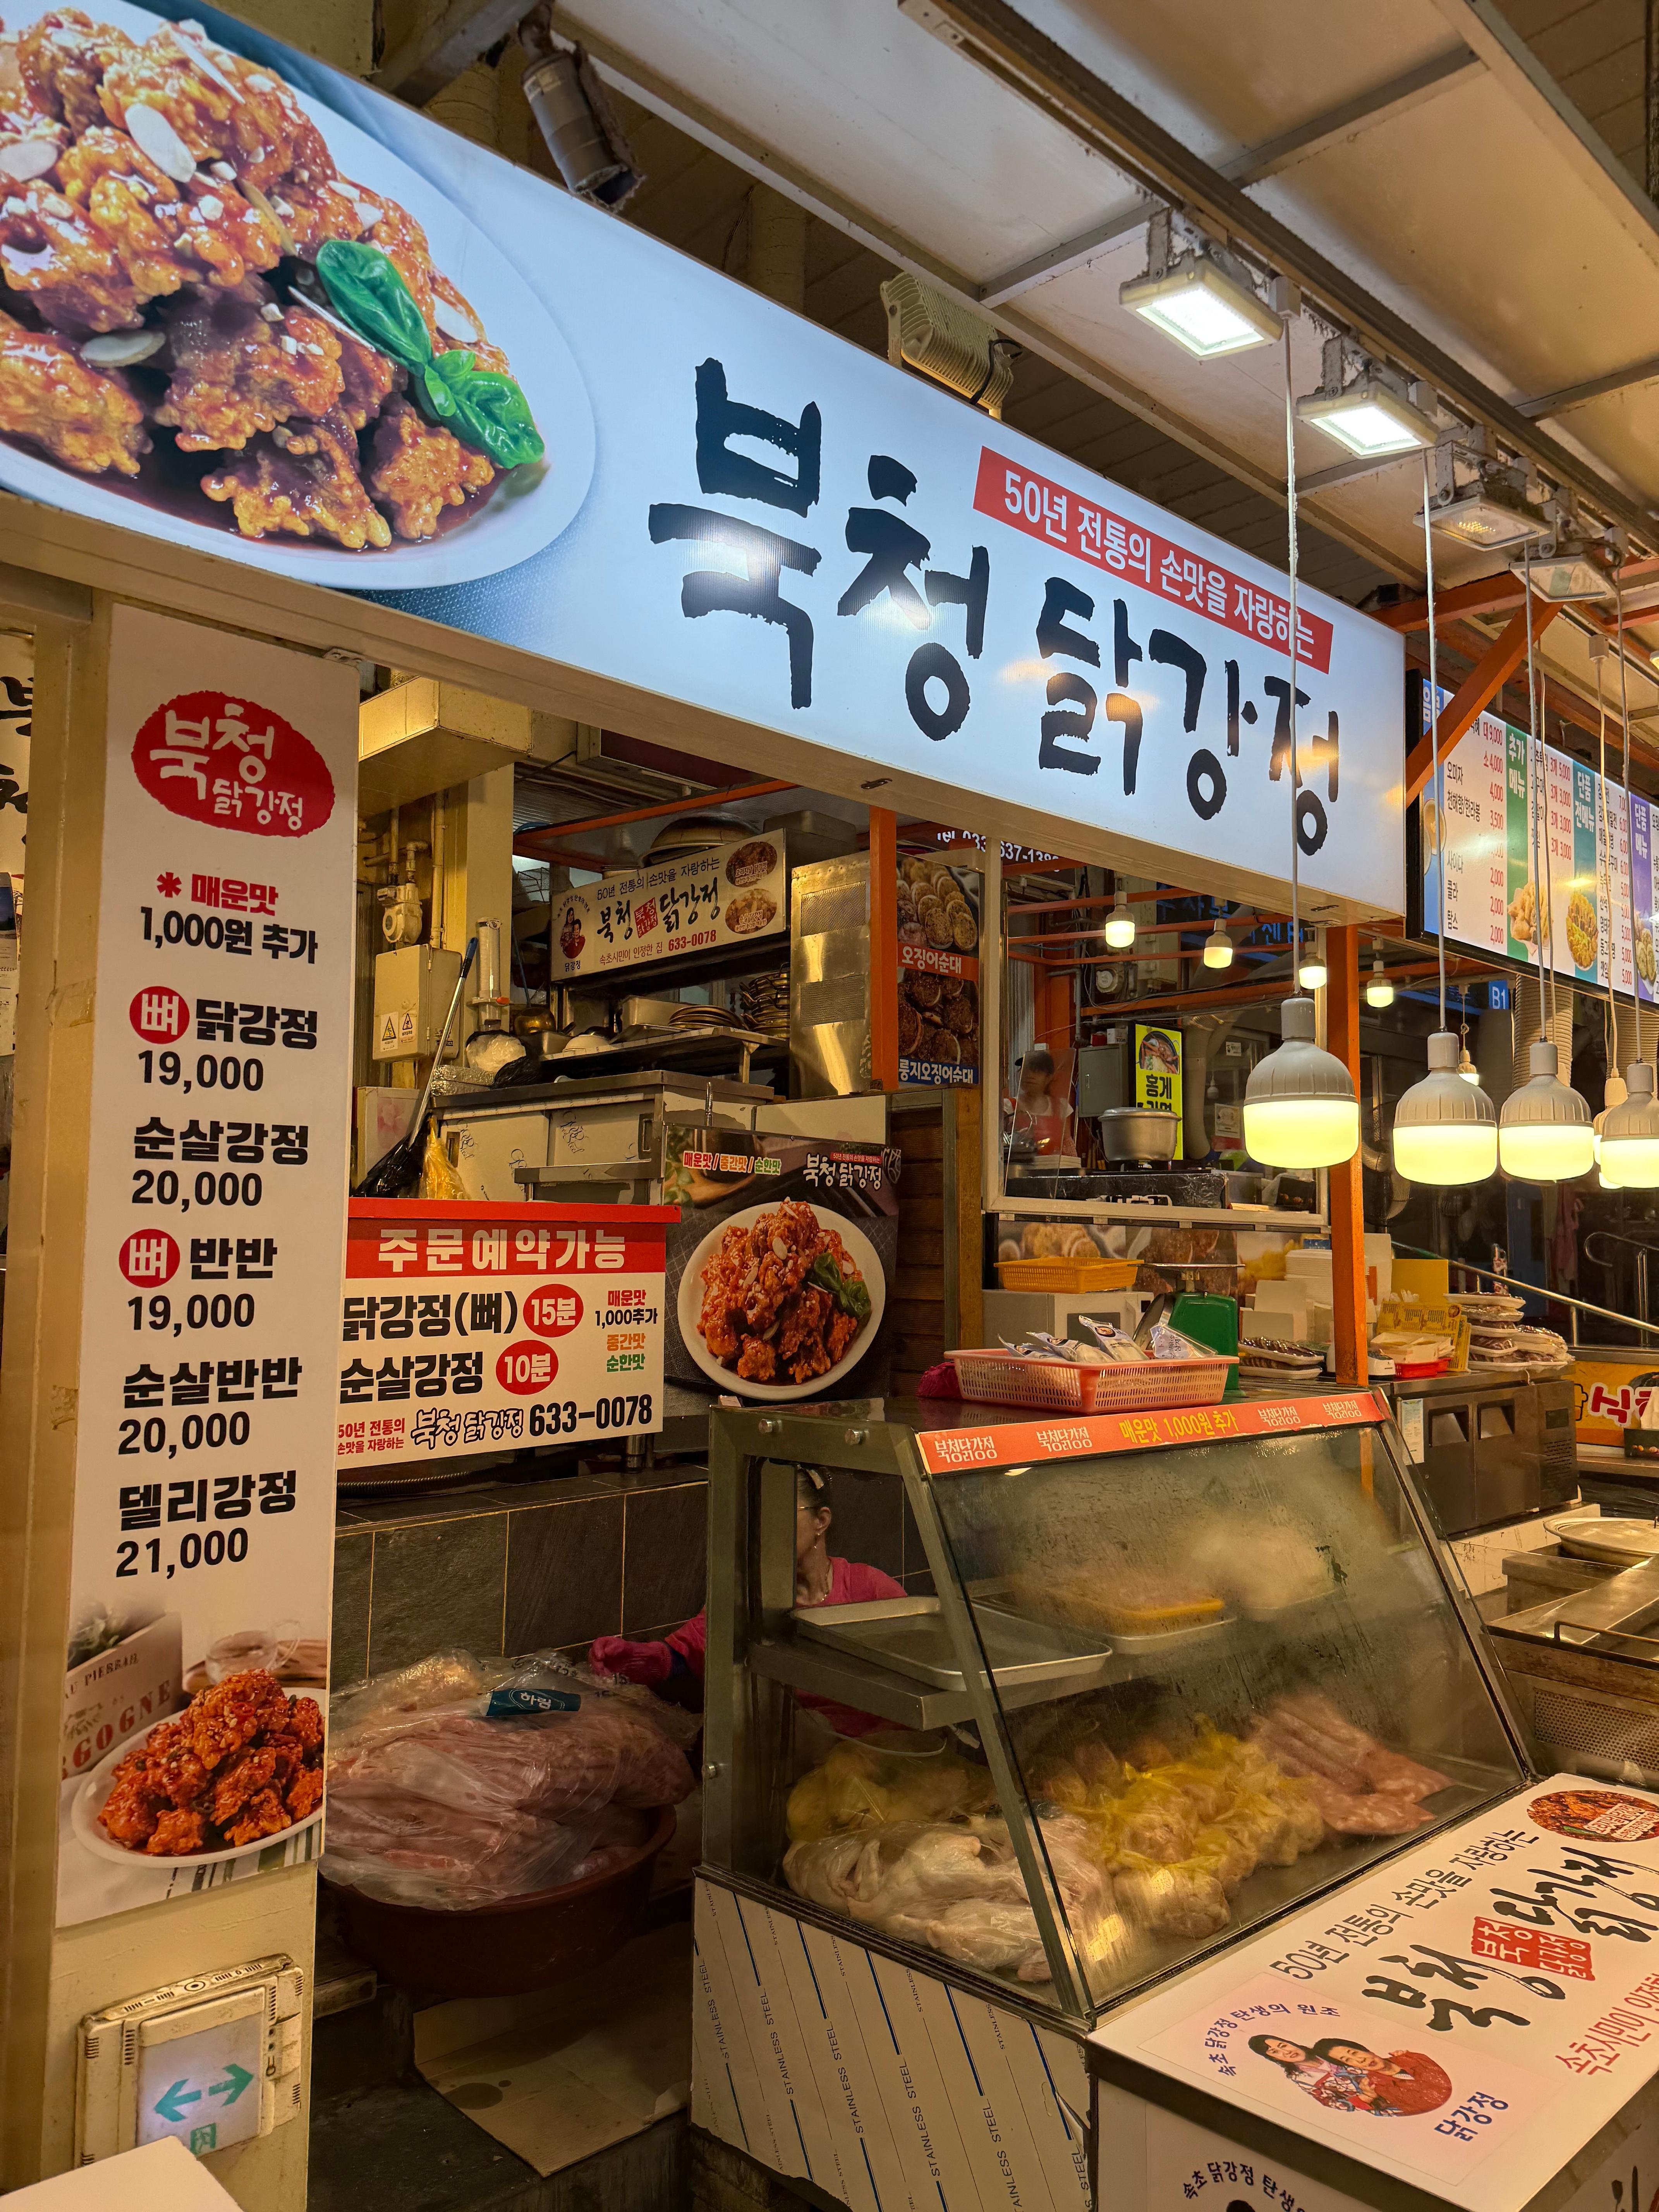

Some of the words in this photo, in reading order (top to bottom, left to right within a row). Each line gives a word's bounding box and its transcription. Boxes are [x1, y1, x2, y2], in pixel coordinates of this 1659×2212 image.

[1005, 469, 1067, 543] 50년
[1077, 505, 1151, 583] 전통의
[1160, 550, 1227, 619] 손맛을
[1234, 584, 1314, 659] 자랑하는
[649, 357, 990, 742] 북청
[1036, 577, 1340, 856] 닭강정
[150, 703, 275, 801] 북청
[1489, 724, 1503, 746] 9,000
[1508, 733, 1525, 765] 추가
[1447, 761, 1463, 785] 오미자
[1489, 782, 1503, 802] 4,000
[1483, 750, 1489, 768] 소
[1489, 754, 1503, 774] 4,000
[1559, 762, 1570, 781] 5,000
[213, 777, 303, 831] 닭강정
[1509, 768, 1525, 799] 메뉴
[1559, 788, 1571, 808] 3,000
[1447, 789, 1480, 823] 천해향/한라봉
[1490, 809, 1503, 830] 3,500
[1560, 815, 1571, 834] 3,000
[1447, 850, 1464, 874] 사이다
[1490, 867, 1504, 888] 2,000
[1560, 842, 1571, 860] 3,000
[191, 873, 278, 917] 매운맛
[620, 876, 644, 895] 전통의
[648, 869, 677, 887] 손맛을
[681, 857, 720, 877] 자랑하는
[597, 900, 633, 943] 북청
[659, 877, 720, 933] 닭강정
[1490, 896, 1504, 916] 2,000
[141, 906, 252, 956] 1,000원
[262, 924, 318, 964] 추가
[599, 949, 631, 966] 속초시민이
[633, 944, 653, 959] 인정한
[656, 941, 663, 953] 집
[668, 929, 716, 952] 633-0078
[1490, 925, 1504, 945] 2,000
[902, 945, 962, 974] 오징어순대
[1622, 968, 1632, 986] 5,000
[1492, 986, 1506, 1006] B1
[140, 992, 179, 1036] 뼈
[195, 998, 318, 1051] 닭강정
[138, 1051, 264, 1094] 19,000
[134, 1116, 309, 1166] 순살강정
[683, 1151, 713, 1170] 매운맛
[720, 1153, 748, 1173] 중간맛
[754, 1156, 781, 1175] 순한맛
[803, 1153, 836, 1187] 북청
[839, 1162, 882, 1190] 닭강정
[132, 1170, 262, 1212] 20,000
[128, 1237, 168, 1279] 뼈
[190, 1237, 278, 1280] 반반
[378, 1228, 625, 1273] 주문예약가능
[127, 1293, 255, 1338] 19,000
[342, 1290, 518, 1341] 닭강정(뼈)
[530, 1295, 577, 1327] 15분
[595, 1307, 658, 1330] 1,000추가
[608, 1289, 647, 1307] 매운맛
[606, 1333, 646, 1352] 중간맛
[606, 1353, 646, 1372] 순한맛
[123, 1357, 302, 1410] 순살반반
[339, 1351, 483, 1405] 순살강정
[504, 1353, 551, 1384] 10분
[118, 1411, 250, 1460] 20,000
[338, 1421, 365, 1439] 50년
[369, 1418, 405, 1436] 전통의
[410, 1407, 461, 1450] 북청
[464, 1408, 524, 1444] 닭강정
[529, 1393, 653, 1437] 633-0078
[1118, 1417, 1163, 1445] 매운맛
[1163, 1412, 1214, 1442] 1,000원
[1213, 1410, 1240, 1434] 추가
[337, 1440, 365, 1455] 손맛을
[368, 1437, 404, 1452] 자랑하는
[118, 1470, 297, 1531] 델리강정
[116, 1527, 249, 1580] 21,000
[1269, 1940, 1349, 1981] 50년
[1325, 1903, 1414, 1949] 전통의
[1390, 1868, 1473, 1915] 손맛을
[1449, 1829, 1540, 1871] 자랑하는
[830, 1935, 846, 1977] STAINLESS
[1477, 1918, 1534, 1963] 북청
[1538, 1932, 1587, 1978] 닭강정
[699, 1960, 712, 1993] STEEL
[905, 1968, 923, 2013] STAINLESS
[1361, 1944, 1566, 2032] 북청
[760, 1989, 774, 2025] STEEL
[986, 2003, 1005, 2050] STAINLESS
[1230, 2003, 1292, 2021] 탄생의
[1297, 2004, 1341, 2017] 원조
[708, 1999, 730, 2059] STAINLESS
[826, 2022, 842, 2061] STEEL
[1204, 2018, 1238, 2049] 닭강정
[1555, 2006, 1659, 2075] 속초시민이
[771, 2032, 794, 2095] STAINLESS
[899, 2058, 917, 2099] STEEL
[1209, 2053, 1237, 2076] 속초
[838, 2067, 864, 2134] STAINLESS
[1434, 2090, 1510, 2143] 닭강정
[912, 2106, 940, 2177] STAINLESS
[982, 2100, 1001, 2143] STEEL
[1071, 2144, 1089, 2191] STEEL
[1183, 2170, 1207, 2200] 속초
[1207, 2161, 1254, 2186] 닭강정
